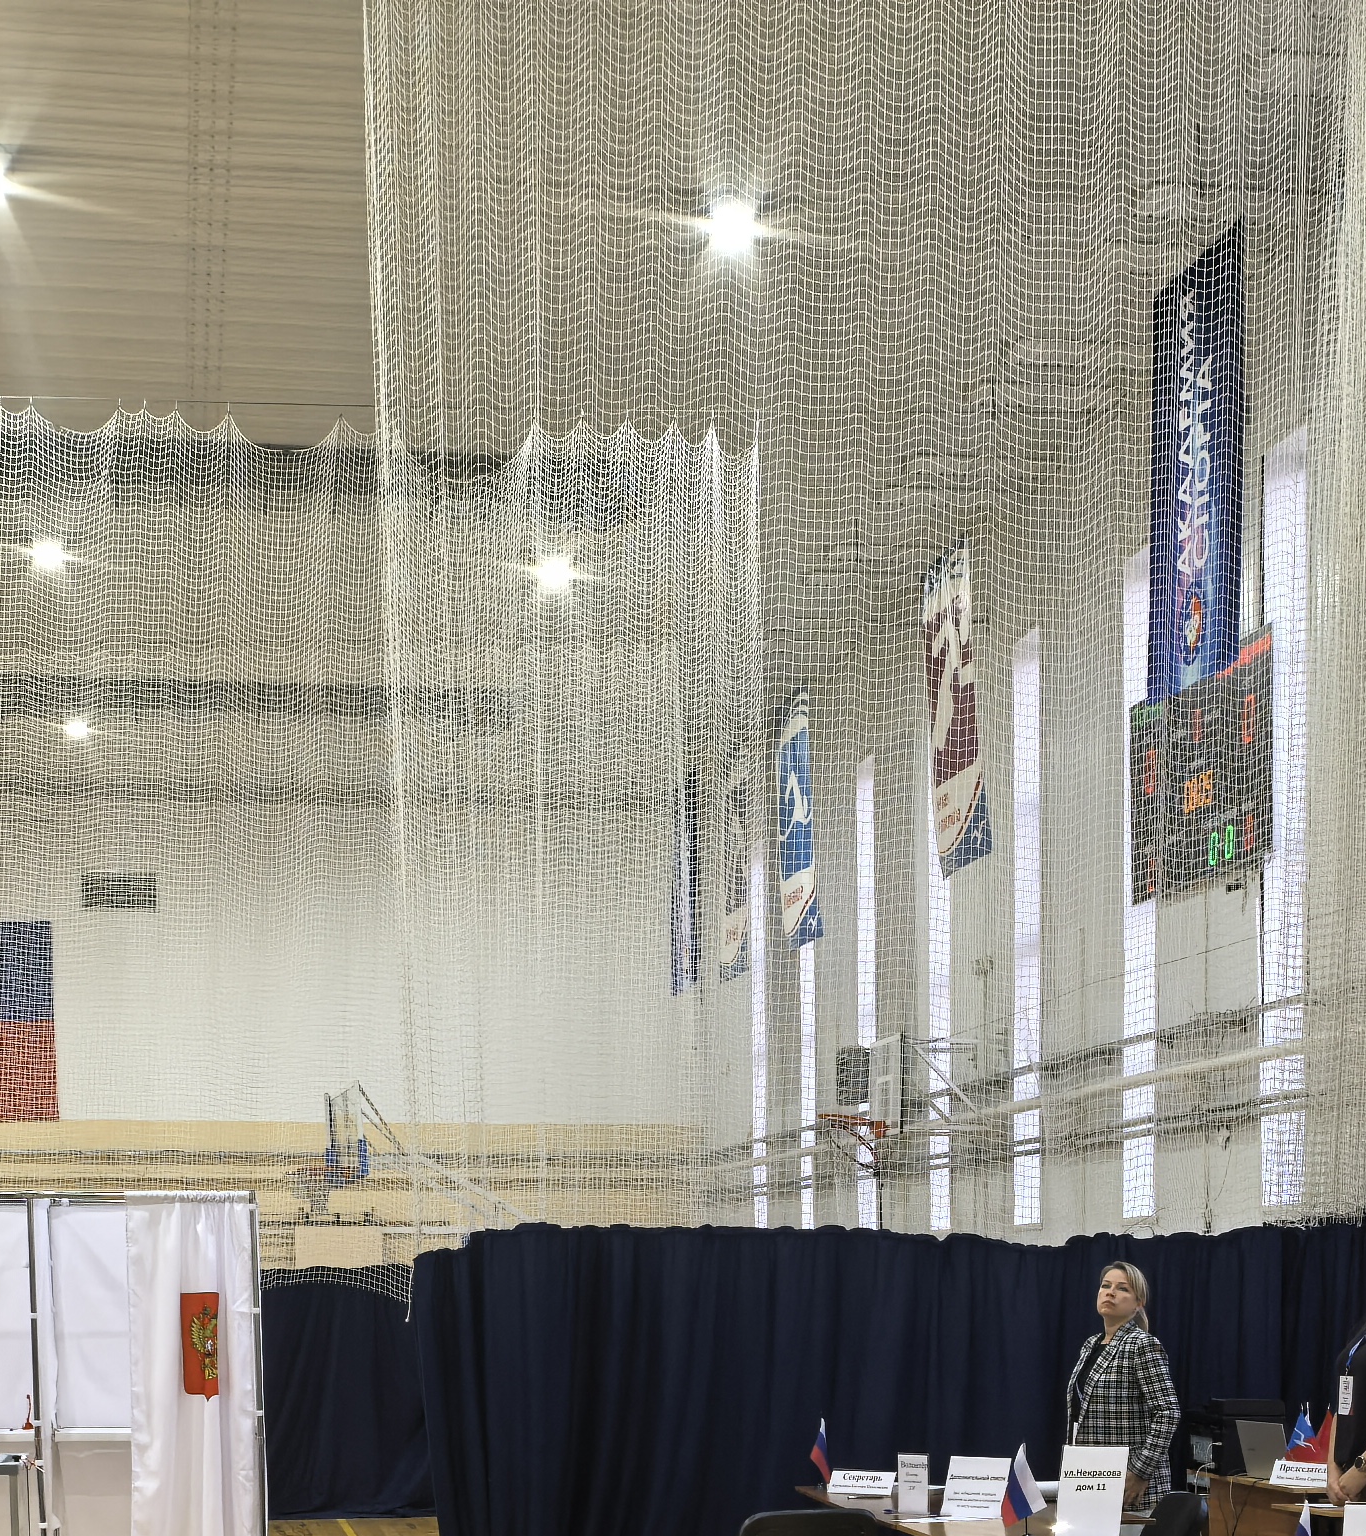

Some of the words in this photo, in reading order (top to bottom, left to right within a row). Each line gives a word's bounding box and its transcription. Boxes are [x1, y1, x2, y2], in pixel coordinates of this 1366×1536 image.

[1063, 1468, 1122, 1478] ул.Некрасова
[1279, 1463, 1327, 1474] Председател
[842, 1472, 883, 1484] Секретарь
[1075, 1484, 1094, 1492] дом
[1096, 1483, 1107, 1491] 11
